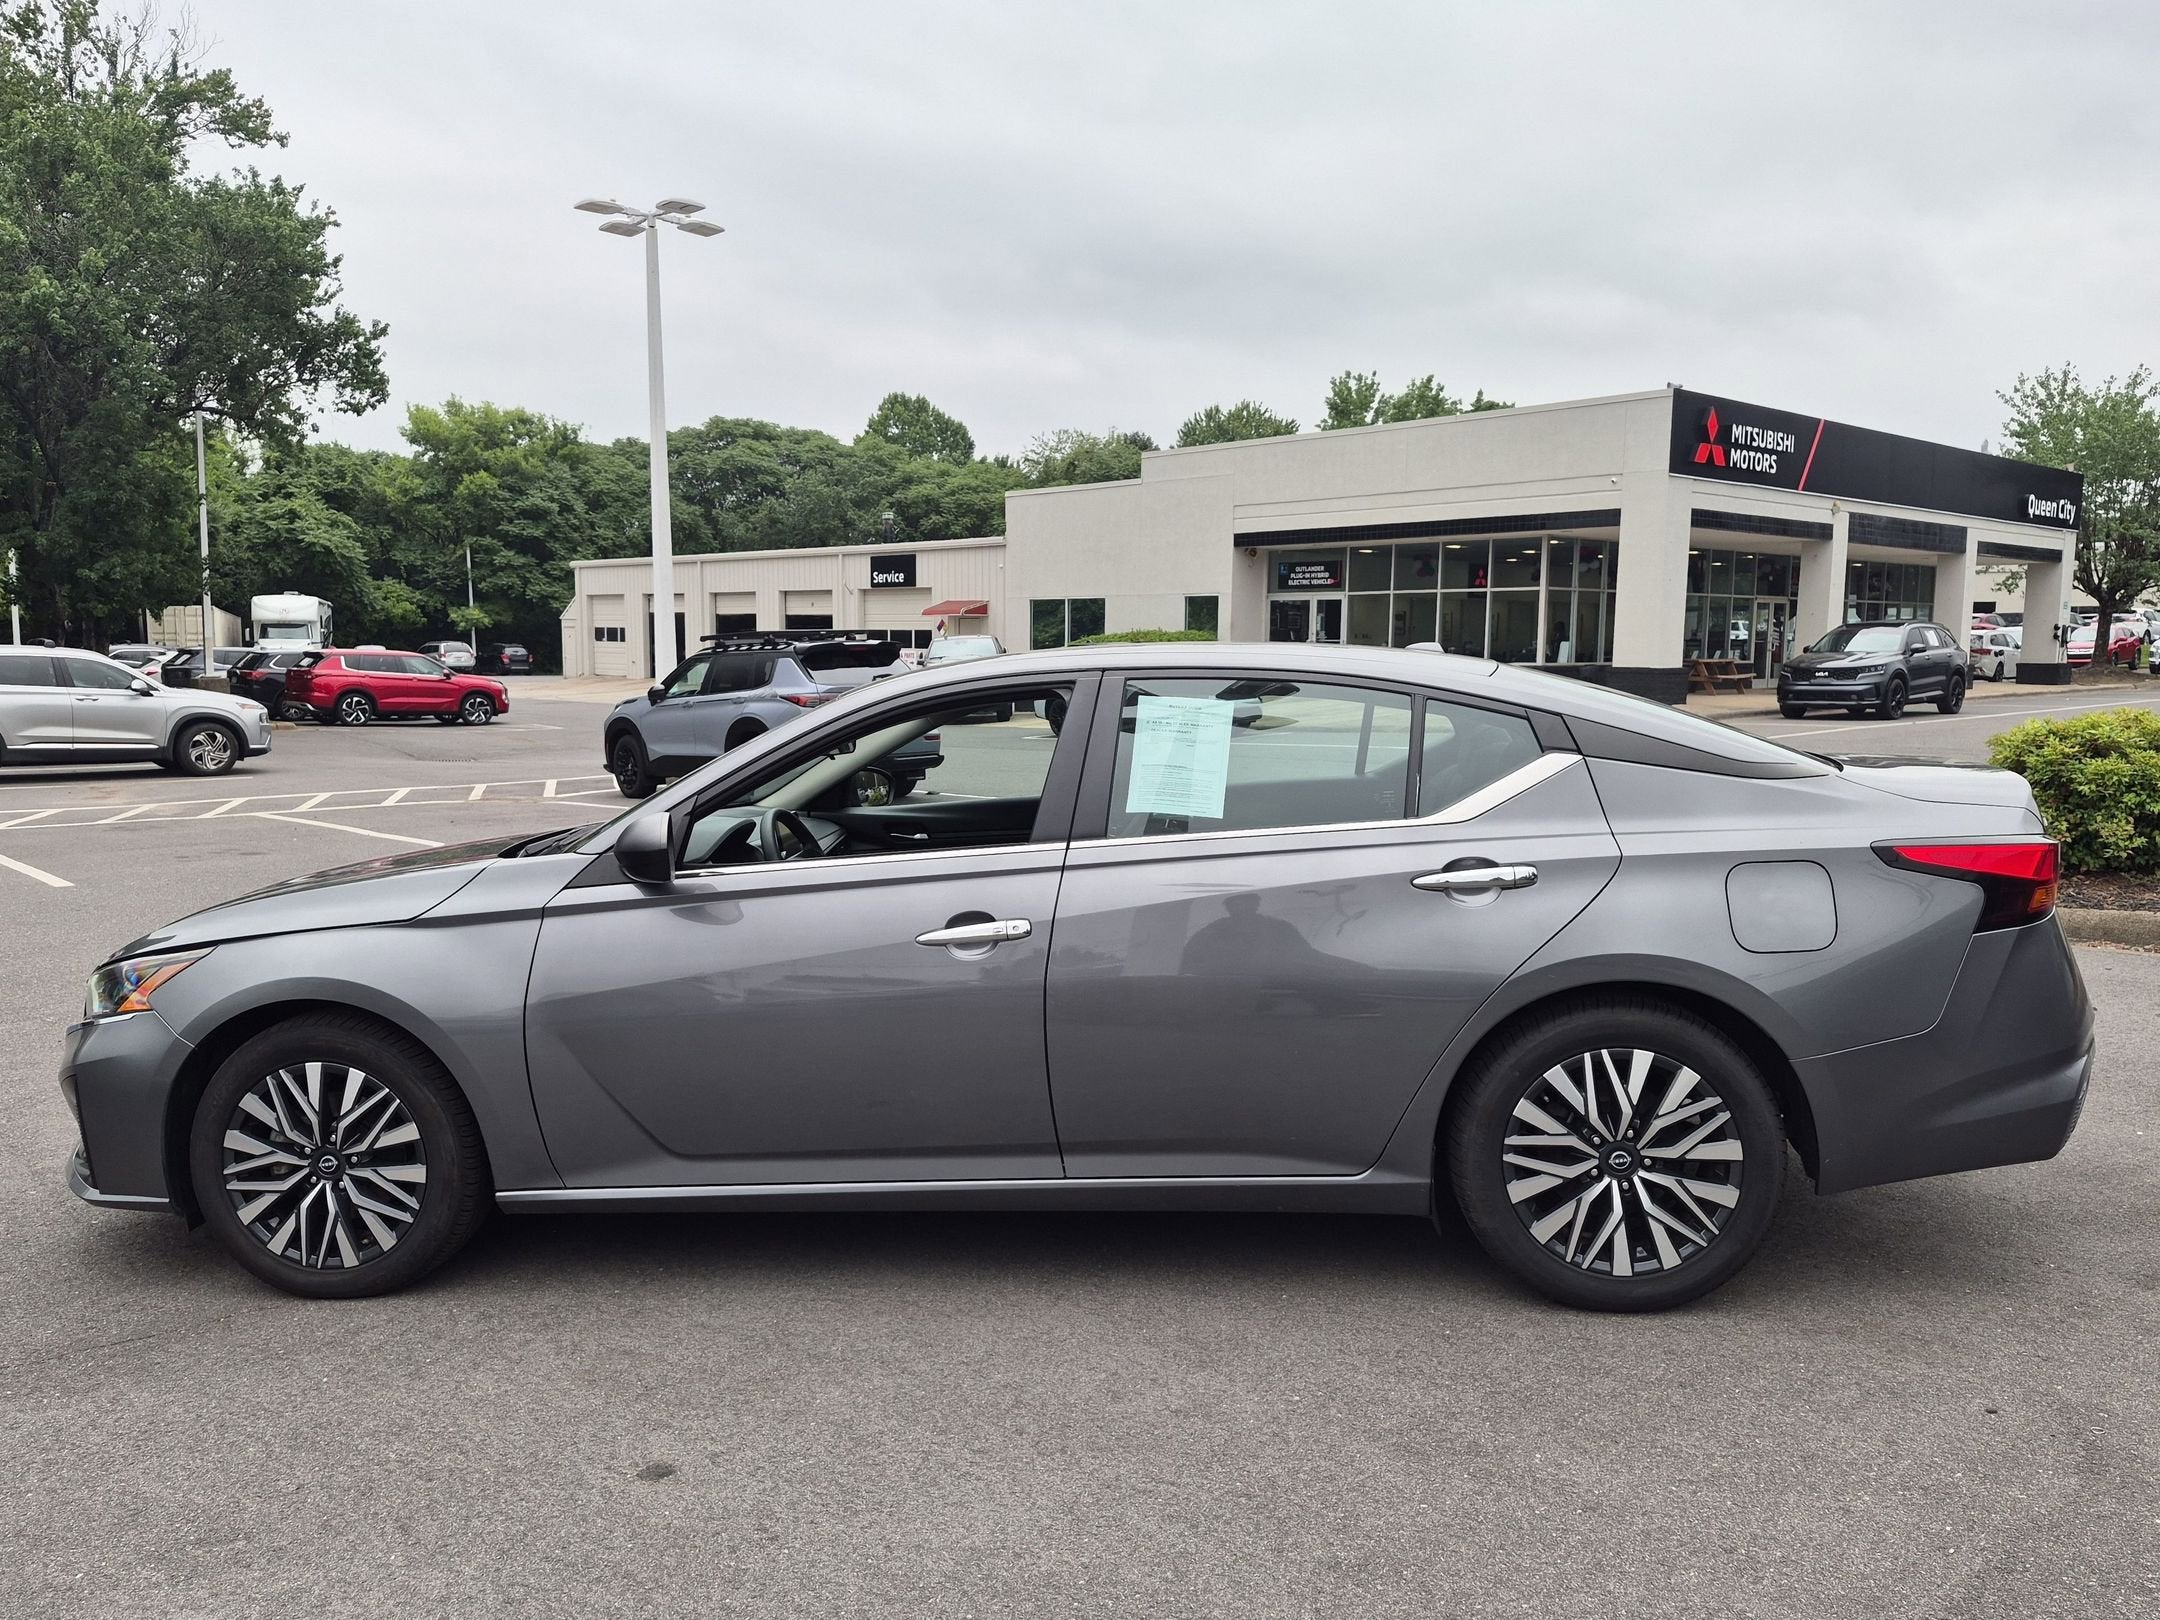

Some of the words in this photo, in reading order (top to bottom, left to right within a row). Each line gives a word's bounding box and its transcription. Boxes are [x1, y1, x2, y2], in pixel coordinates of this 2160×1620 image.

[1731, 423, 1795, 453] MITSUBISHI
[1729, 447, 1777, 474] MOTORS
[2028, 493, 2057, 518] Queen
[2058, 498, 2076, 525] City
[872, 570, 905, 584] Service
